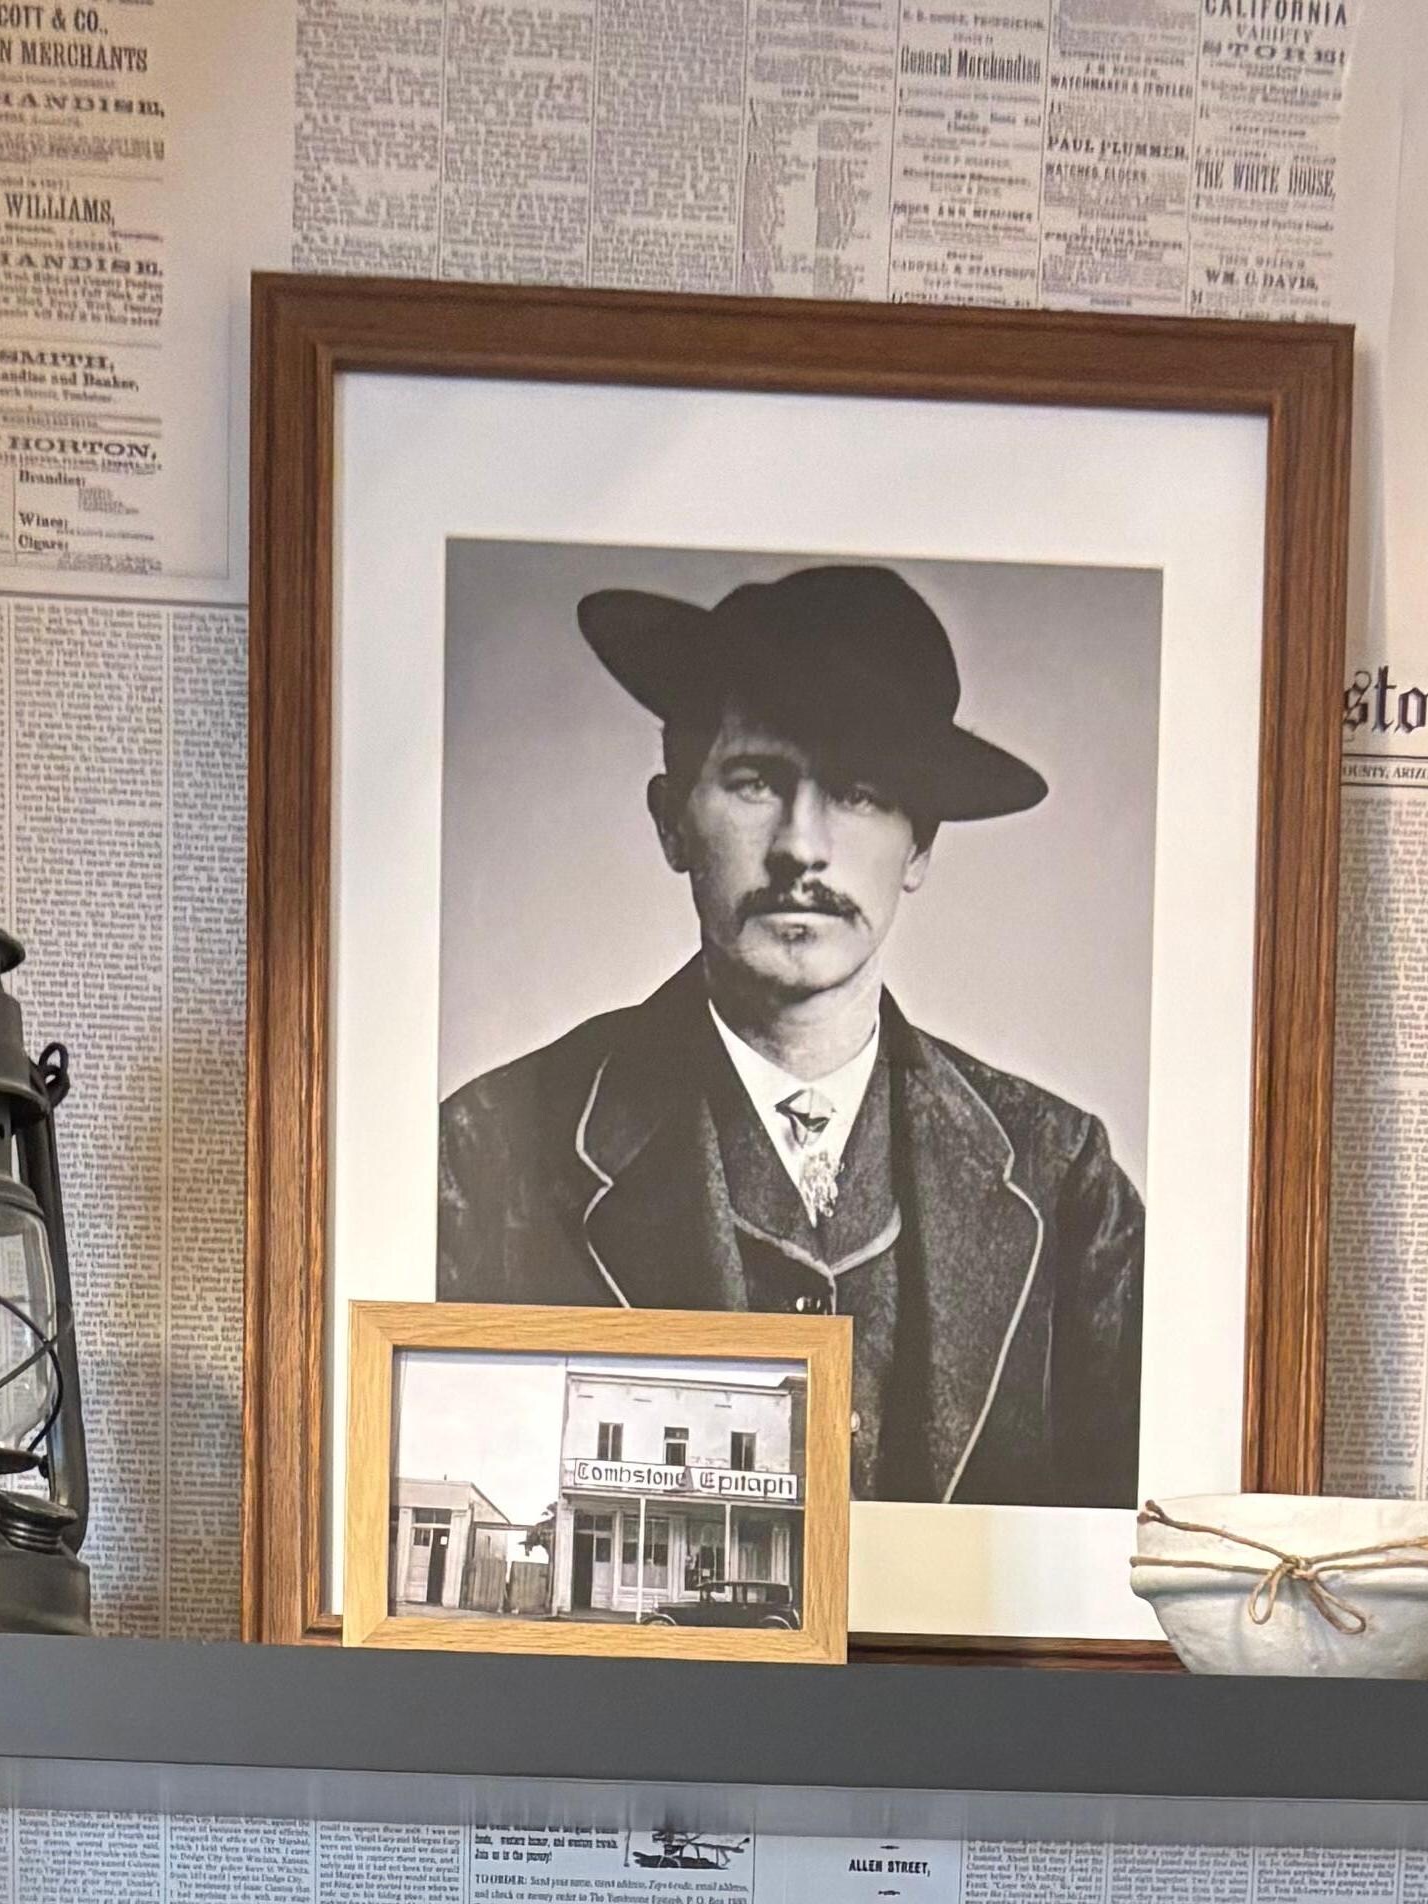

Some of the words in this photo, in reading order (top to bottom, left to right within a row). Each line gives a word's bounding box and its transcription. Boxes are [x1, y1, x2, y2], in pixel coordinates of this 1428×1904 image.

[53, 8, 65, 31] &
[22, 41, 147, 72] MERCHANTS
[1195, 160, 1223, 190] THE
[1232, 162, 1280, 196] WHITE
[577, 1461, 686, 1487] Tombstone
[700, 1472, 793, 1495] Epitaph
[849, 1858, 884, 1875] ALLEN
